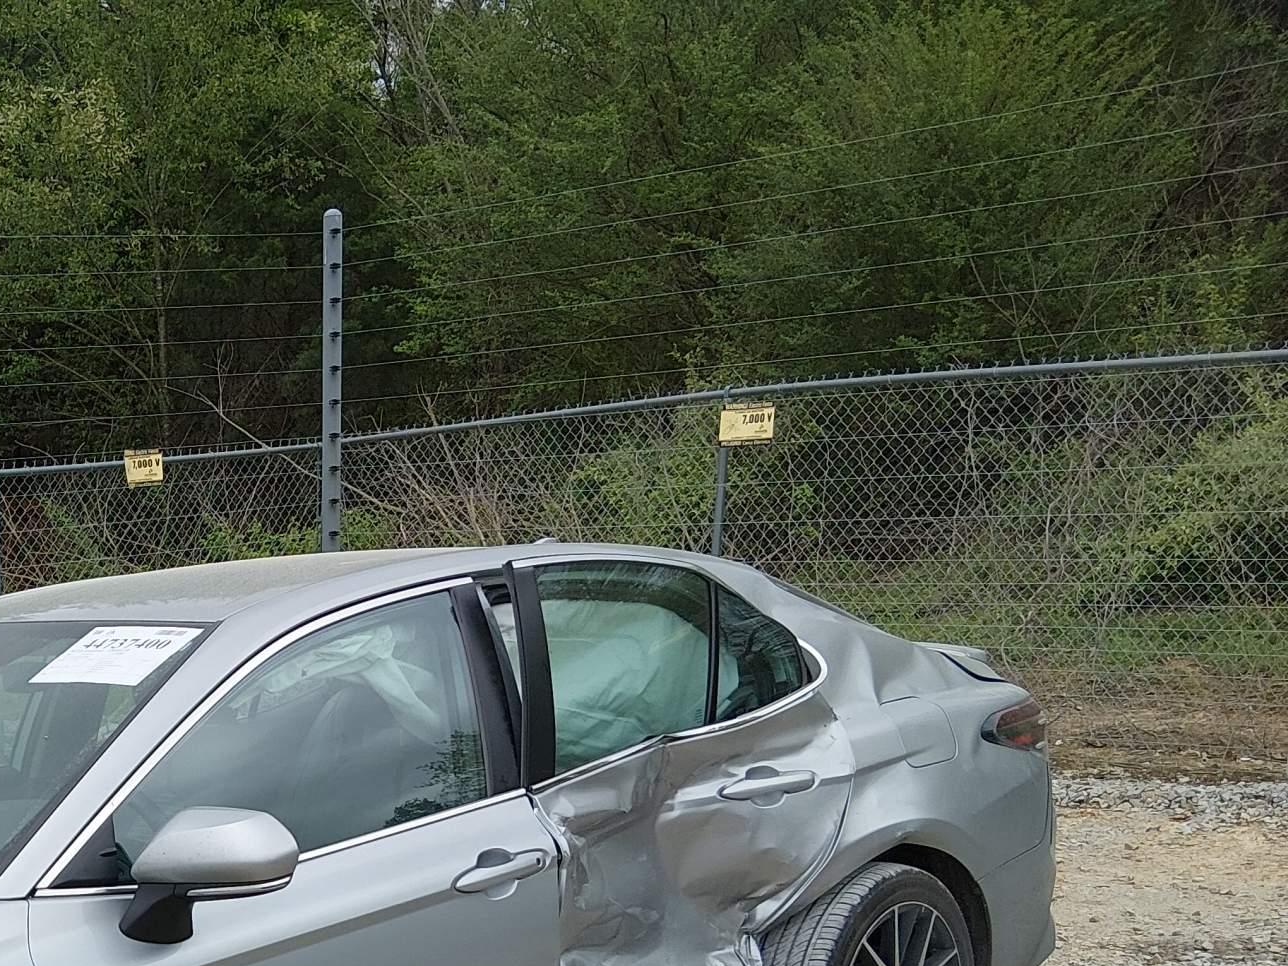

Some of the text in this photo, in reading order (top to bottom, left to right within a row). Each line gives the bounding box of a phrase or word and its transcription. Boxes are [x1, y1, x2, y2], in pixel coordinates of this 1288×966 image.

[742, 412, 773, 425] 7,000 V
[155, 458, 160, 467] V
[82, 637, 172, 650] 44737400
